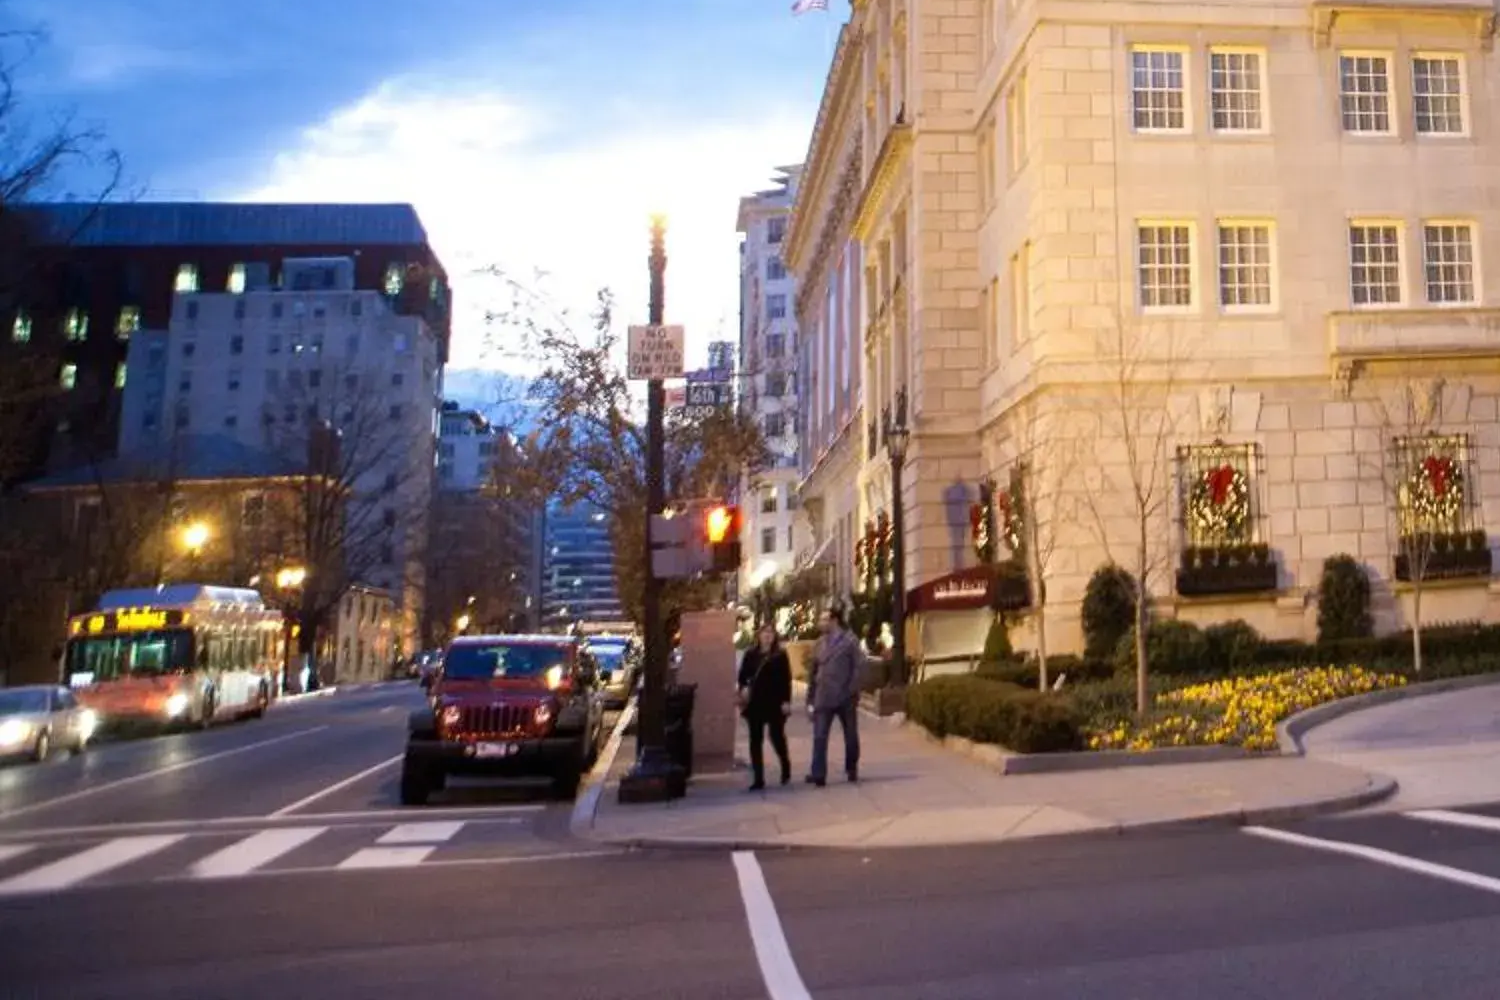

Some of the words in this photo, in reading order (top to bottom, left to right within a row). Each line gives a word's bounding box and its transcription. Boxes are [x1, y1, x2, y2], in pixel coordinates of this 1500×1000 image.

[646, 328, 667, 338] NO
[640, 339, 675, 351] TURN
[631, 352, 650, 363] ON
[654, 352, 681, 363] RED
[689, 385, 715, 403] 16th
